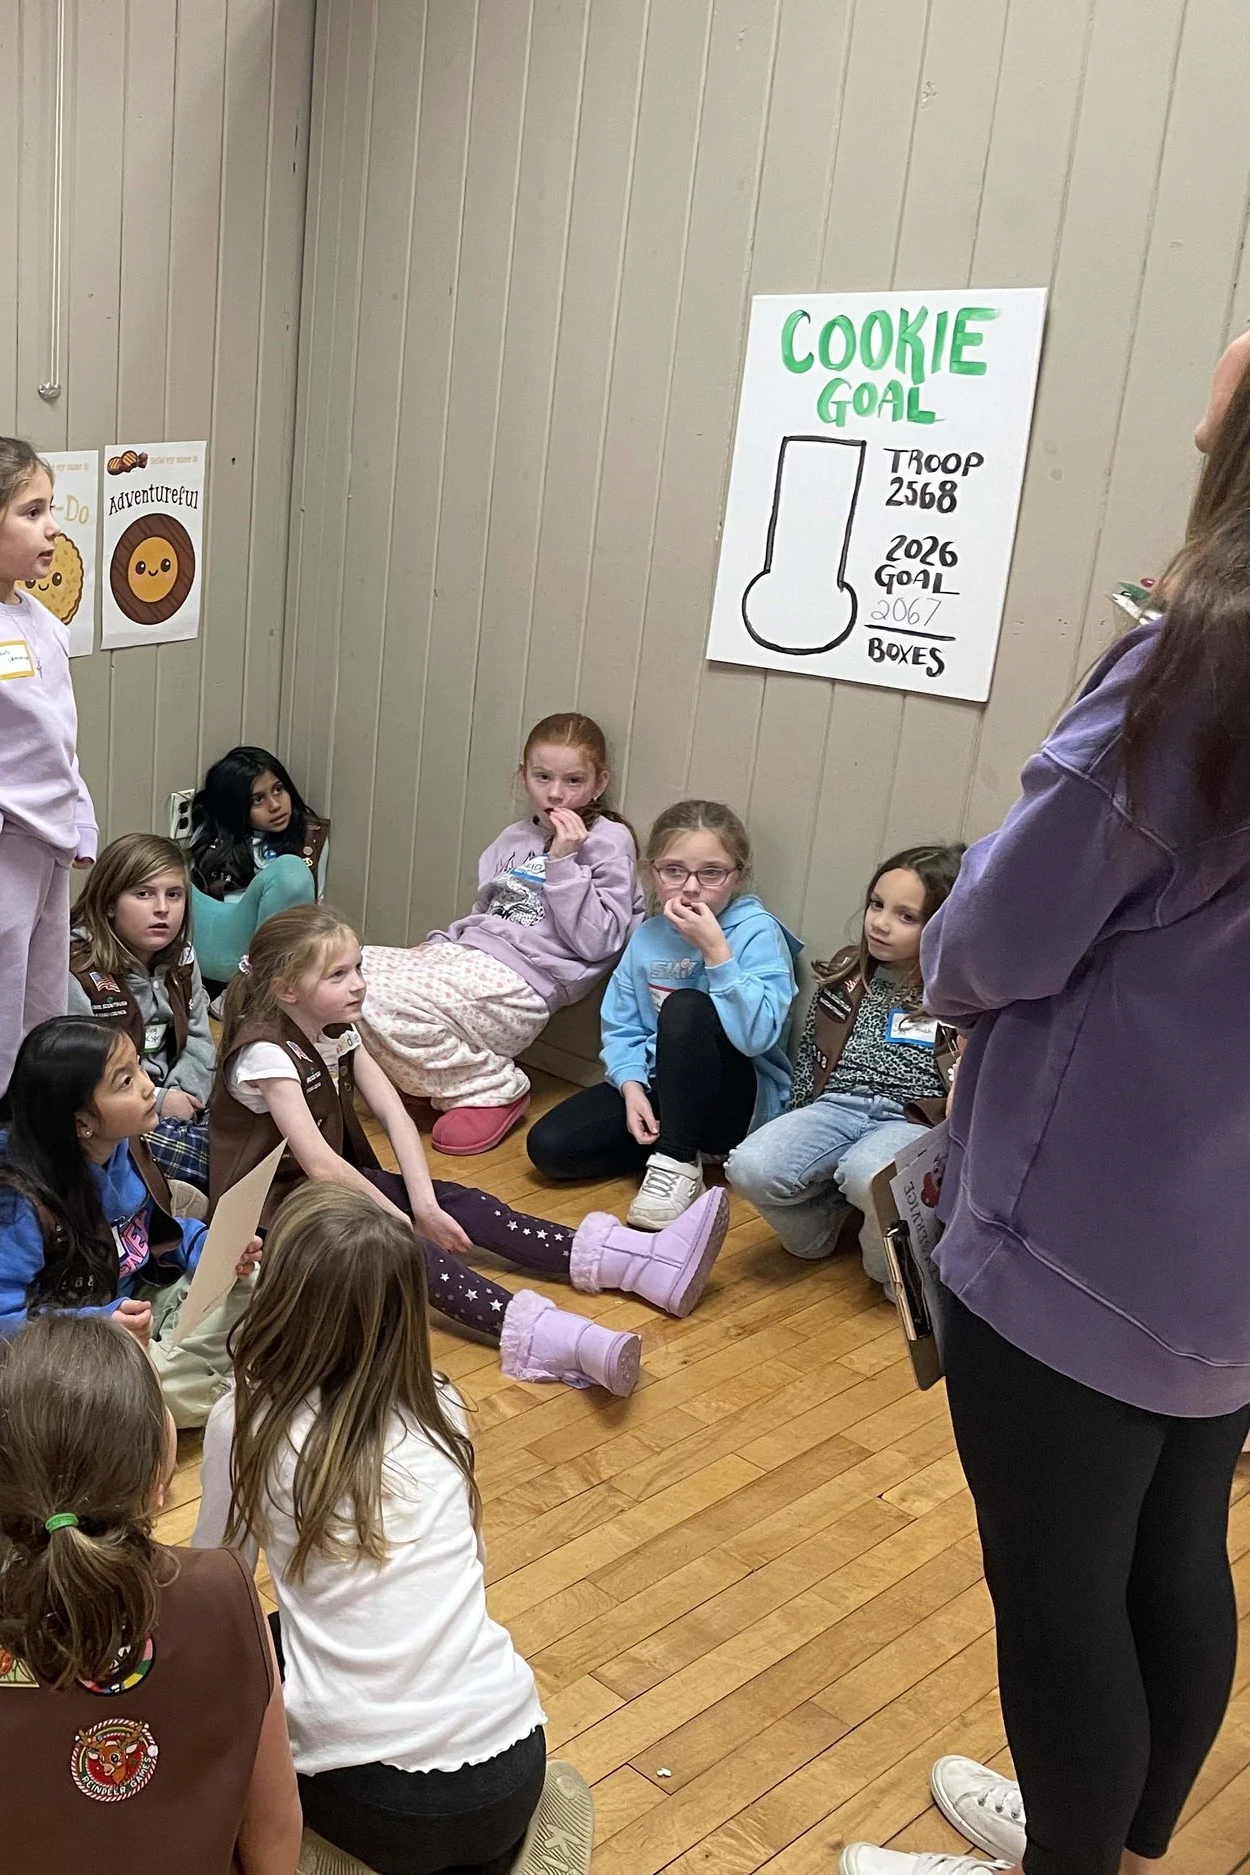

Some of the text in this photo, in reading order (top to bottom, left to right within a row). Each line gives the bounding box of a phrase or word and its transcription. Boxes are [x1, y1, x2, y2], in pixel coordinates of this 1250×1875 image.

[780, 306, 1002, 384] COOKIE
[817, 377, 947, 427] GOAL
[883, 448, 985, 477] TROOP
[109, 484, 198, 516] Adventureful
[885, 477, 958, 514] 2568
[885, 535, 958, 567] 2026
[874, 565, 960, 595] GOAL
[870, 597, 942, 627] 2067
[868, 637, 946, 677] BOXES
[82, 1757, 151, 1796] REINDEER GAMES
